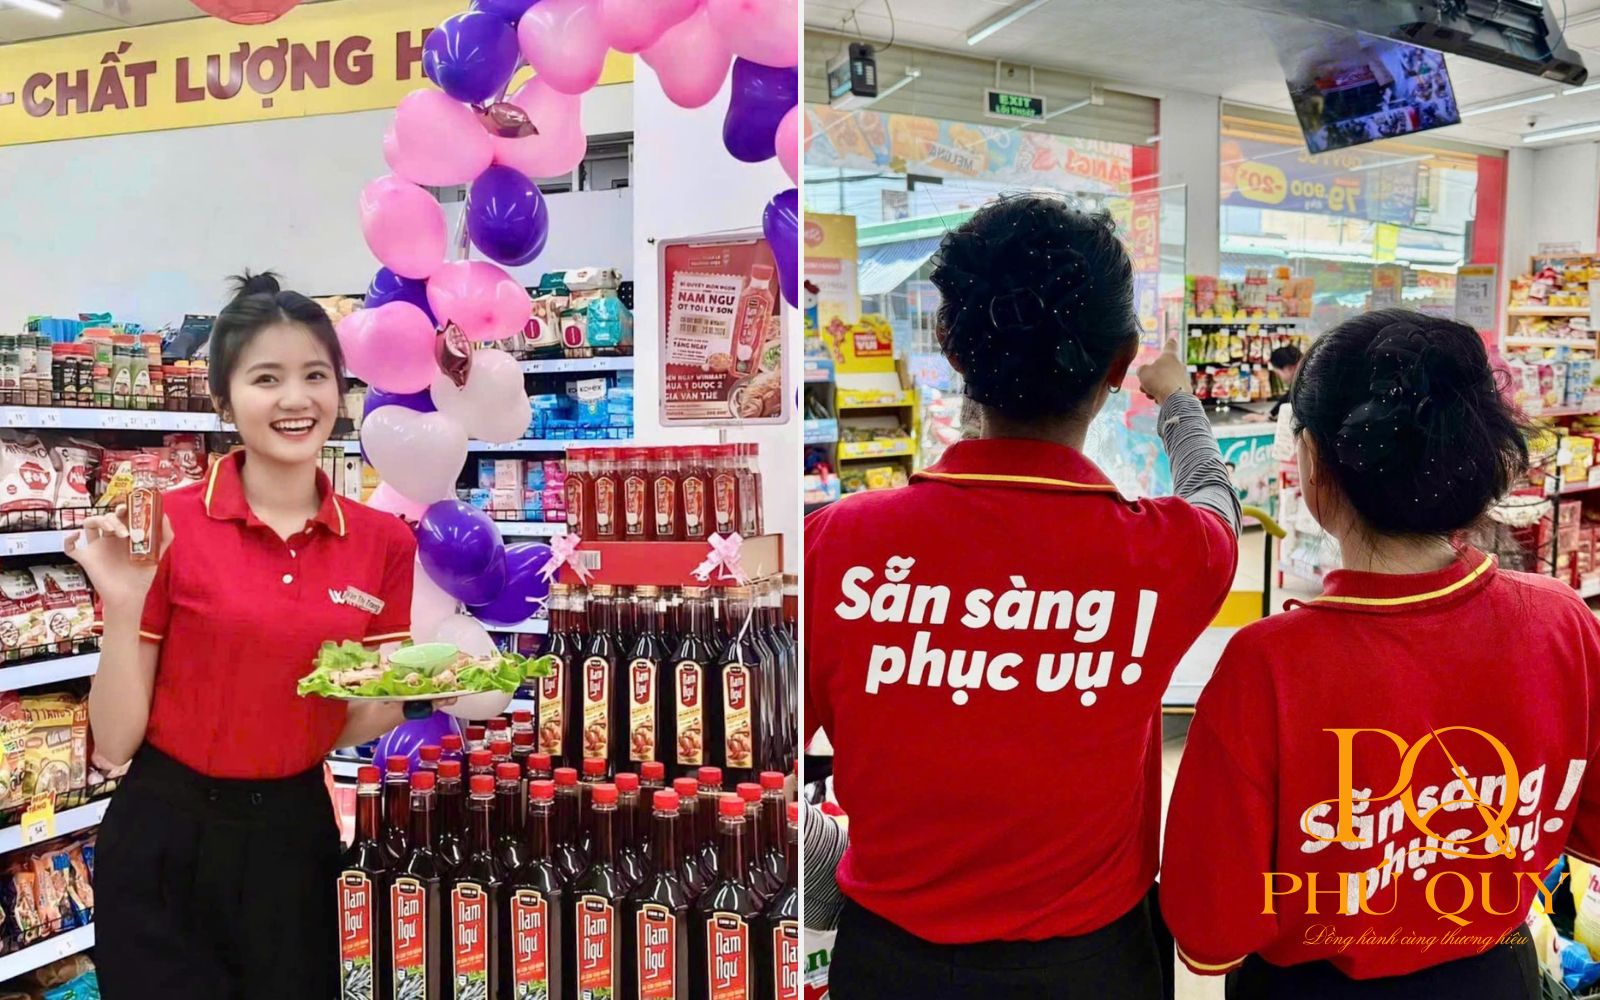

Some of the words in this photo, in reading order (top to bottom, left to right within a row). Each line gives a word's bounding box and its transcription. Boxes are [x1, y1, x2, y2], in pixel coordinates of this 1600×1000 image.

[22, 41, 157, 117] CHẤT
[175, 34, 374, 108] LƯỢNG
[999, 94, 1032, 107] EXIT
[678, 292, 706, 303] NAM
[834, 555, 951, 625] Sẵn
[960, 575, 1116, 644] sàng
[865, 630, 1024, 706] phục
[1035, 650, 1115, 707] vụ
[1417, 763, 1546, 818] sàng
[344, 889, 366, 910] Nam
[397, 896, 419, 917] Nam
[458, 901, 481, 923] Nam
[518, 909, 541, 931] Nam
[584, 914, 607, 937] Nam
[645, 923, 669, 946] Nam
[715, 932, 741, 956] Nam
[782, 940, 798, 965] Na
[783, 965, 798, 998] Ng
